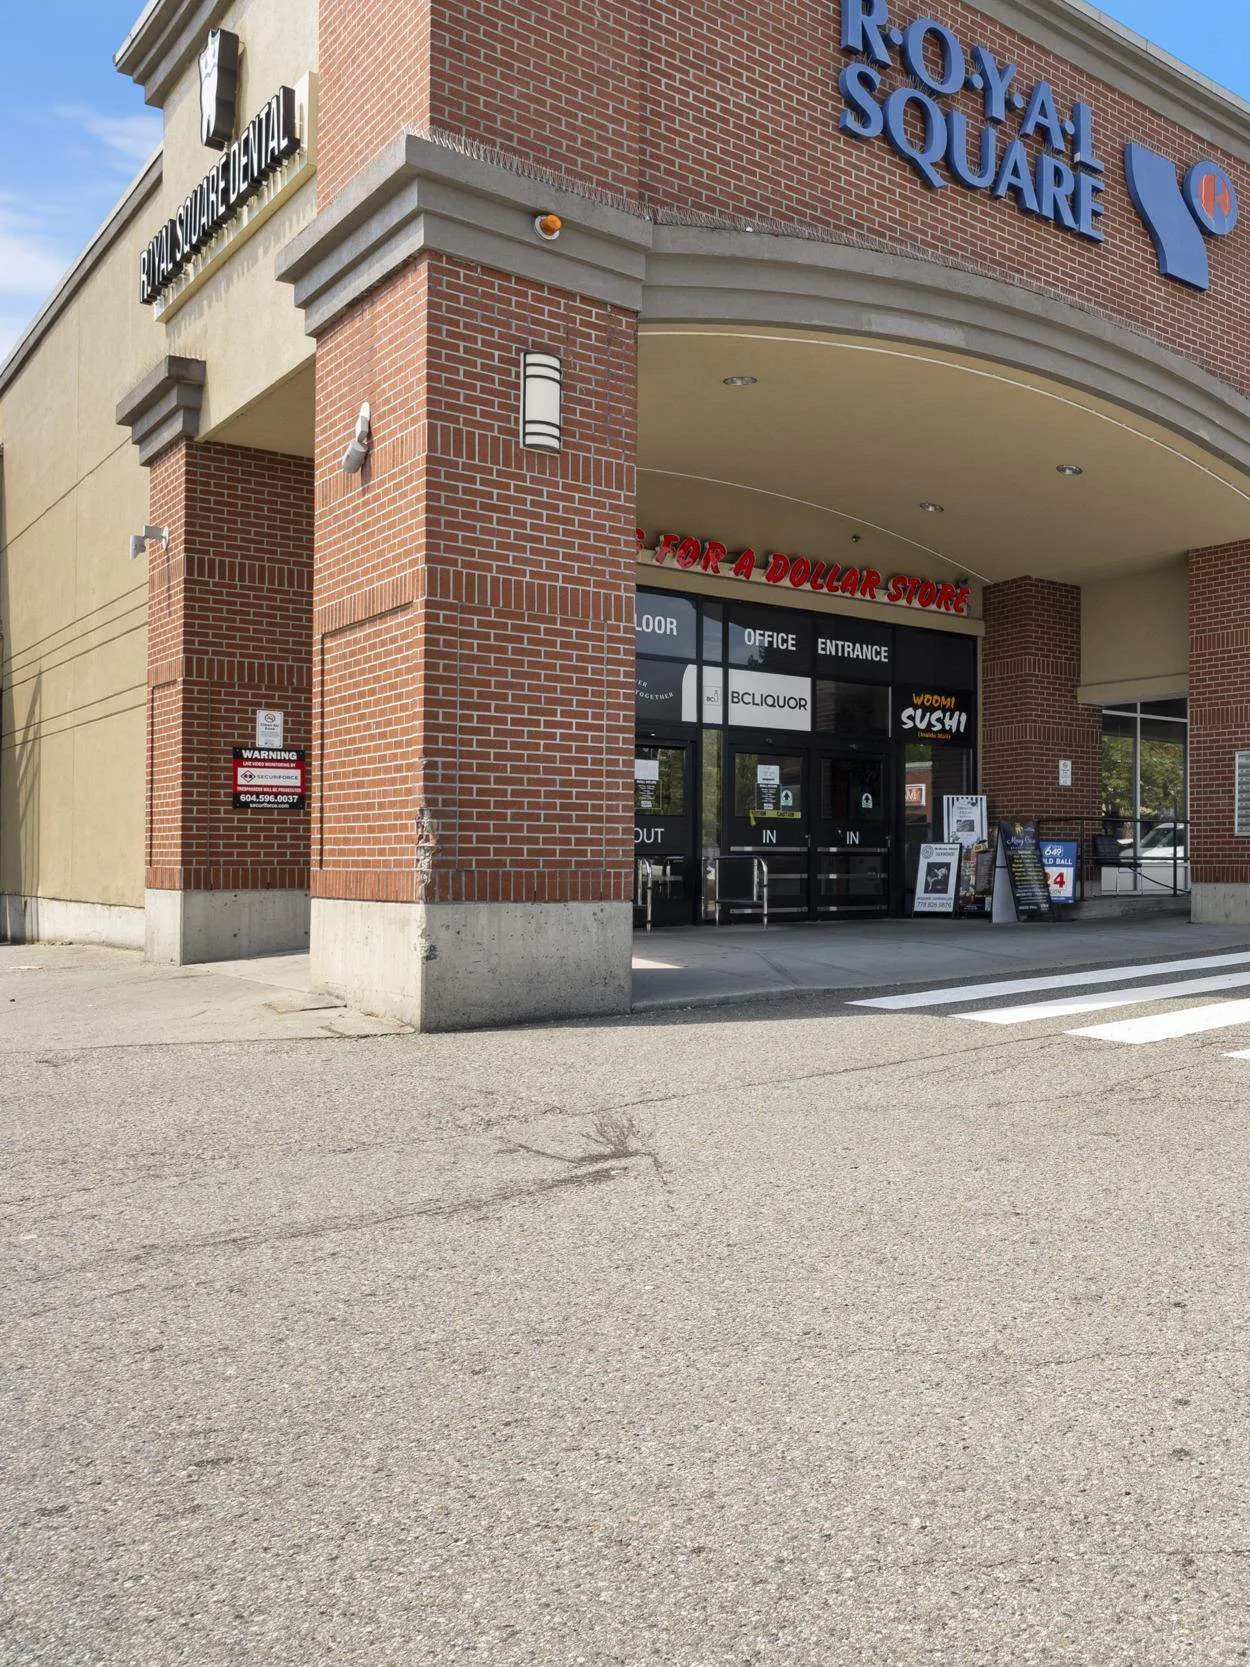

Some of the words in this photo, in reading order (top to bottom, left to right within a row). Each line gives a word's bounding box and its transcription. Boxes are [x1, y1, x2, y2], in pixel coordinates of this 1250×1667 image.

[839, 63, 1104, 243] SQUARE
[175, 153, 231, 262] SQUARE
[229, 86, 294, 203] DENTAL
[654, 533, 727, 574] FOR
[732, 548, 757, 580] A
[765, 552, 882, 599] DOLLAR
[887, 575, 973, 615] STORE
[744, 628, 797, 651] OFFICE
[818, 638, 889, 663] ENTRANCE
[730, 690, 808, 712] BCLIQUOR
[912, 692, 955, 709] WOOMI
[901, 706, 967, 733] SUSHI
[241, 749, 298, 760] WARNING
[240, 794, 299, 803] 604.596.0037
[634, 827, 665, 844] OUT
[762, 829, 777, 844] IN
[846, 829, 860, 845] IN
